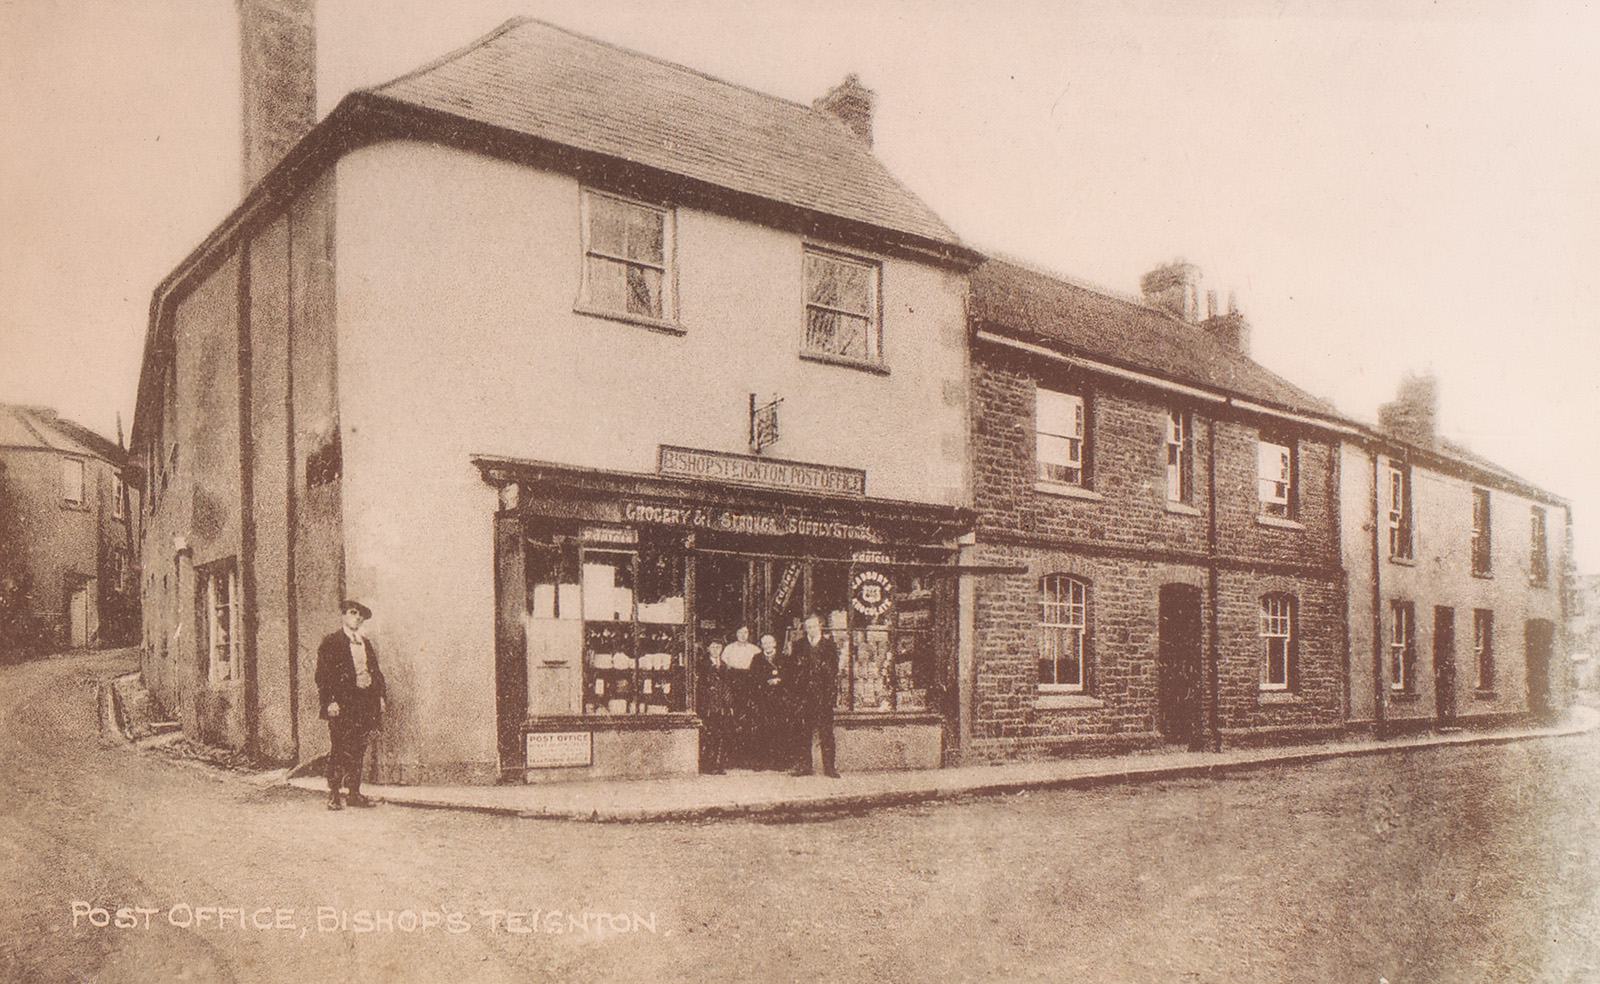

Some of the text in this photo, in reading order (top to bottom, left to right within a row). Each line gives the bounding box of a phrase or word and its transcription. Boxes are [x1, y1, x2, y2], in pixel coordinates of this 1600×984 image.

[791, 465, 819, 487] POST
[820, 470, 861, 492] OFFICE
[626, 503, 691, 525] GROCERY
